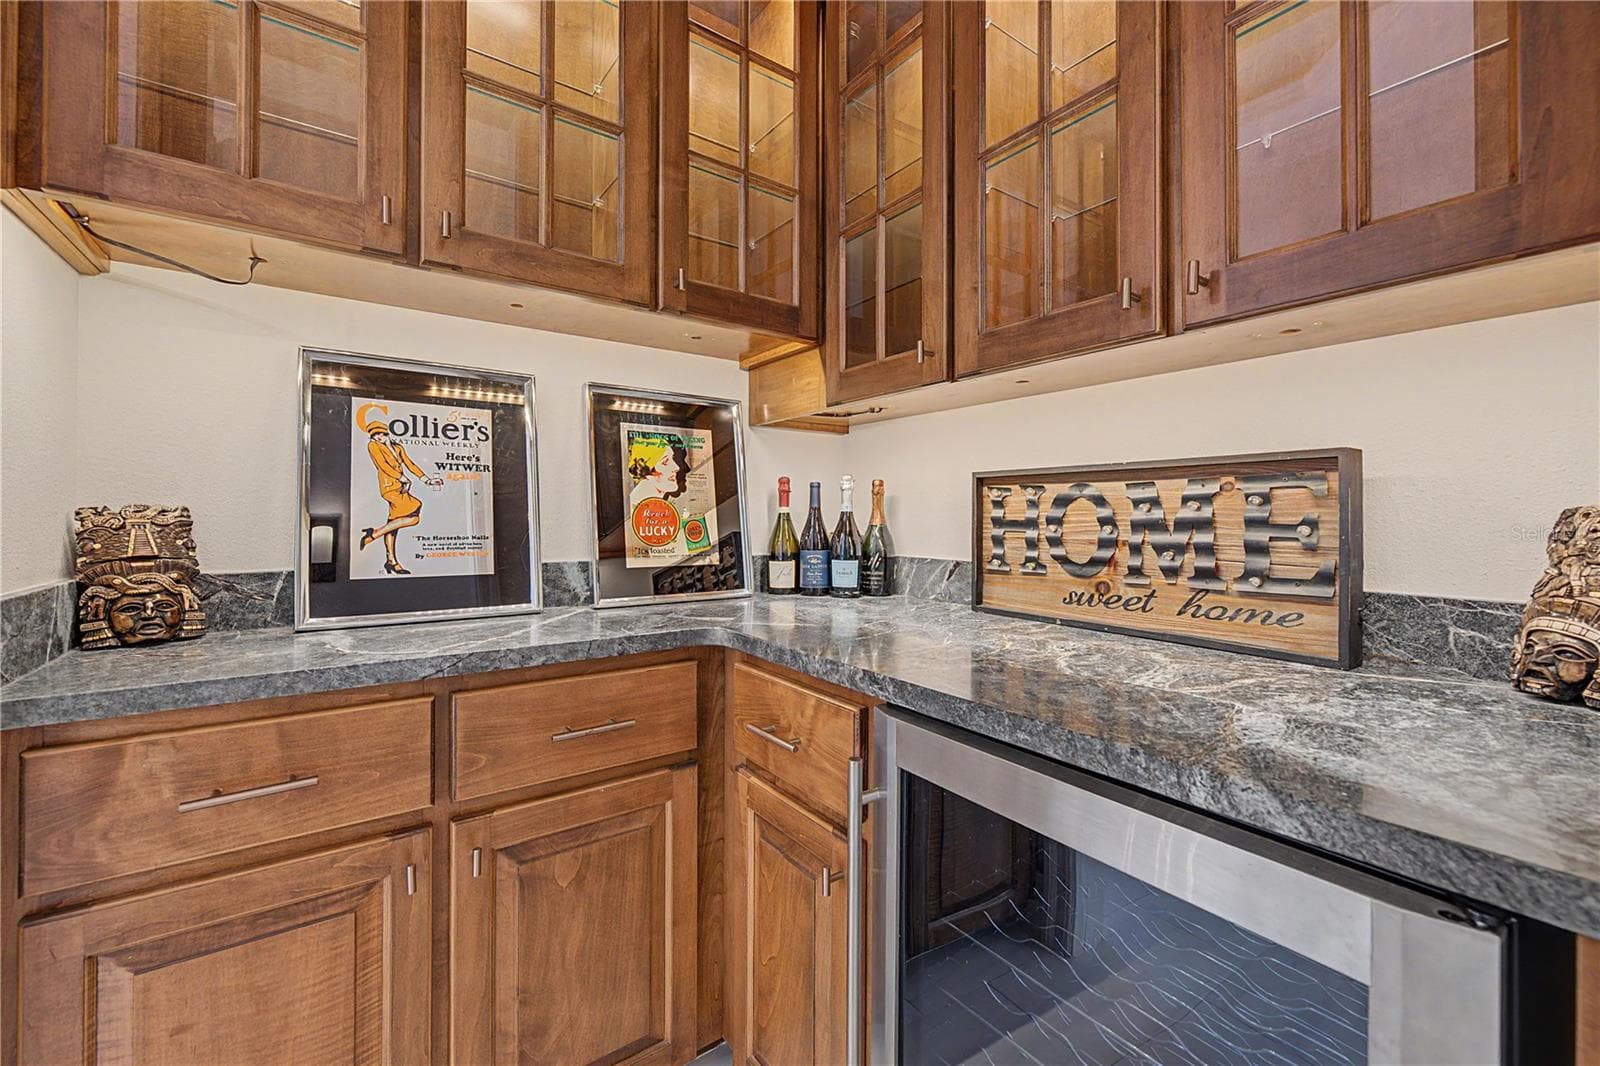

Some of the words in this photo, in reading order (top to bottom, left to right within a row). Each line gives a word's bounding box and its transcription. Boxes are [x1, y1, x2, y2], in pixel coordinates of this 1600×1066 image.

[356, 403, 490, 442] Collier's
[391, 439, 439, 447] NATIONAL
[442, 441, 480, 449] WEEKLY
[446, 452, 481, 462] Here's
[435, 462, 491, 473] WITWER
[640, 526, 675, 536] LUCKY
[985, 470, 1337, 599] HOME
[1062, 588, 1158, 614] sweet
[1175, 588, 1306, 629] home
